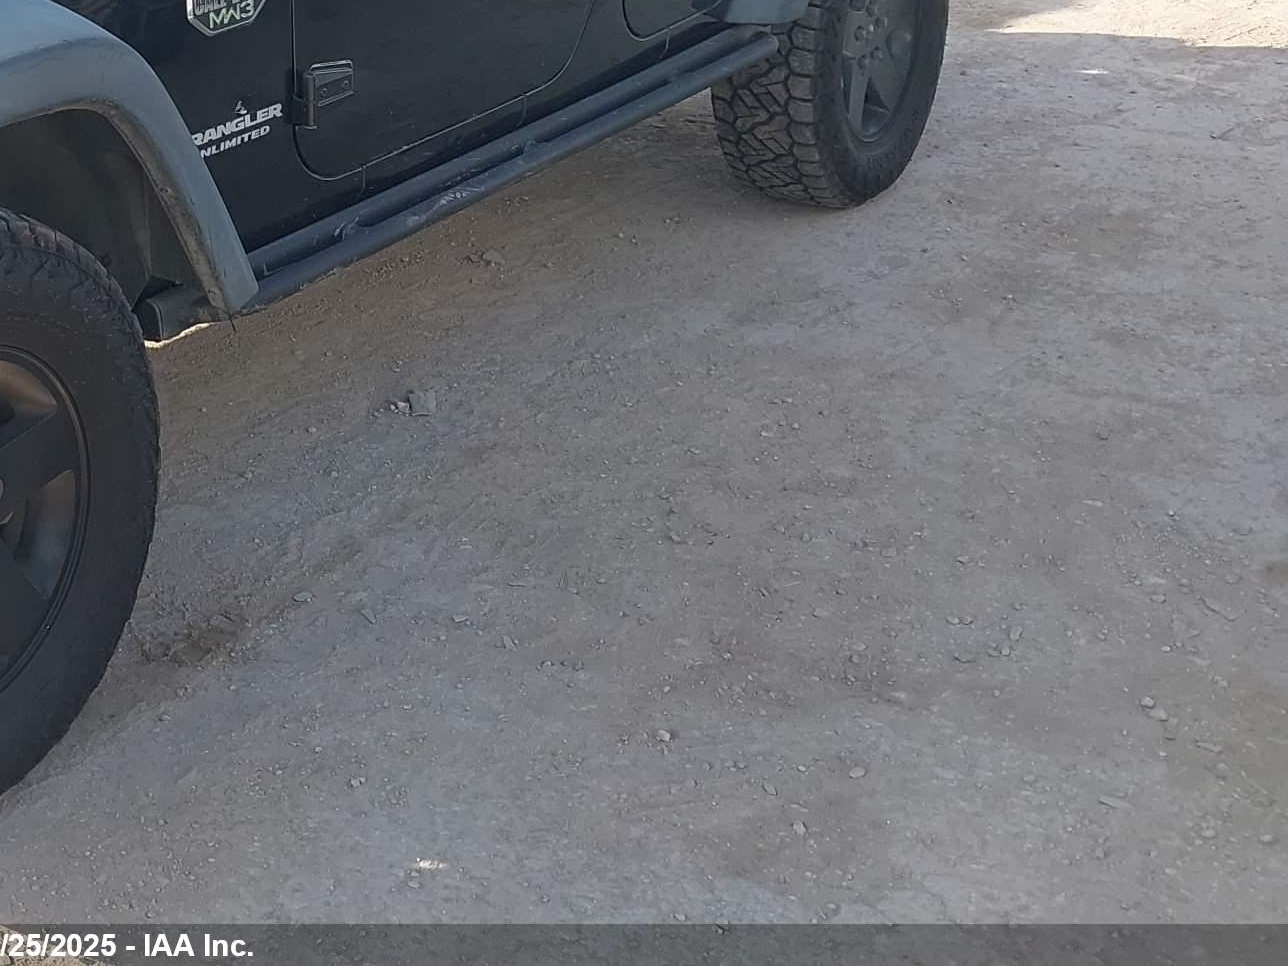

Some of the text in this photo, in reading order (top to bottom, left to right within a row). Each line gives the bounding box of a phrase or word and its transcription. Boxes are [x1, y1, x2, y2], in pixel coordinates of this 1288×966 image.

[209, 0, 254, 29] MW3
[192, 103, 283, 146] RANGLER
[200, 125, 270, 158] NLIMITED
